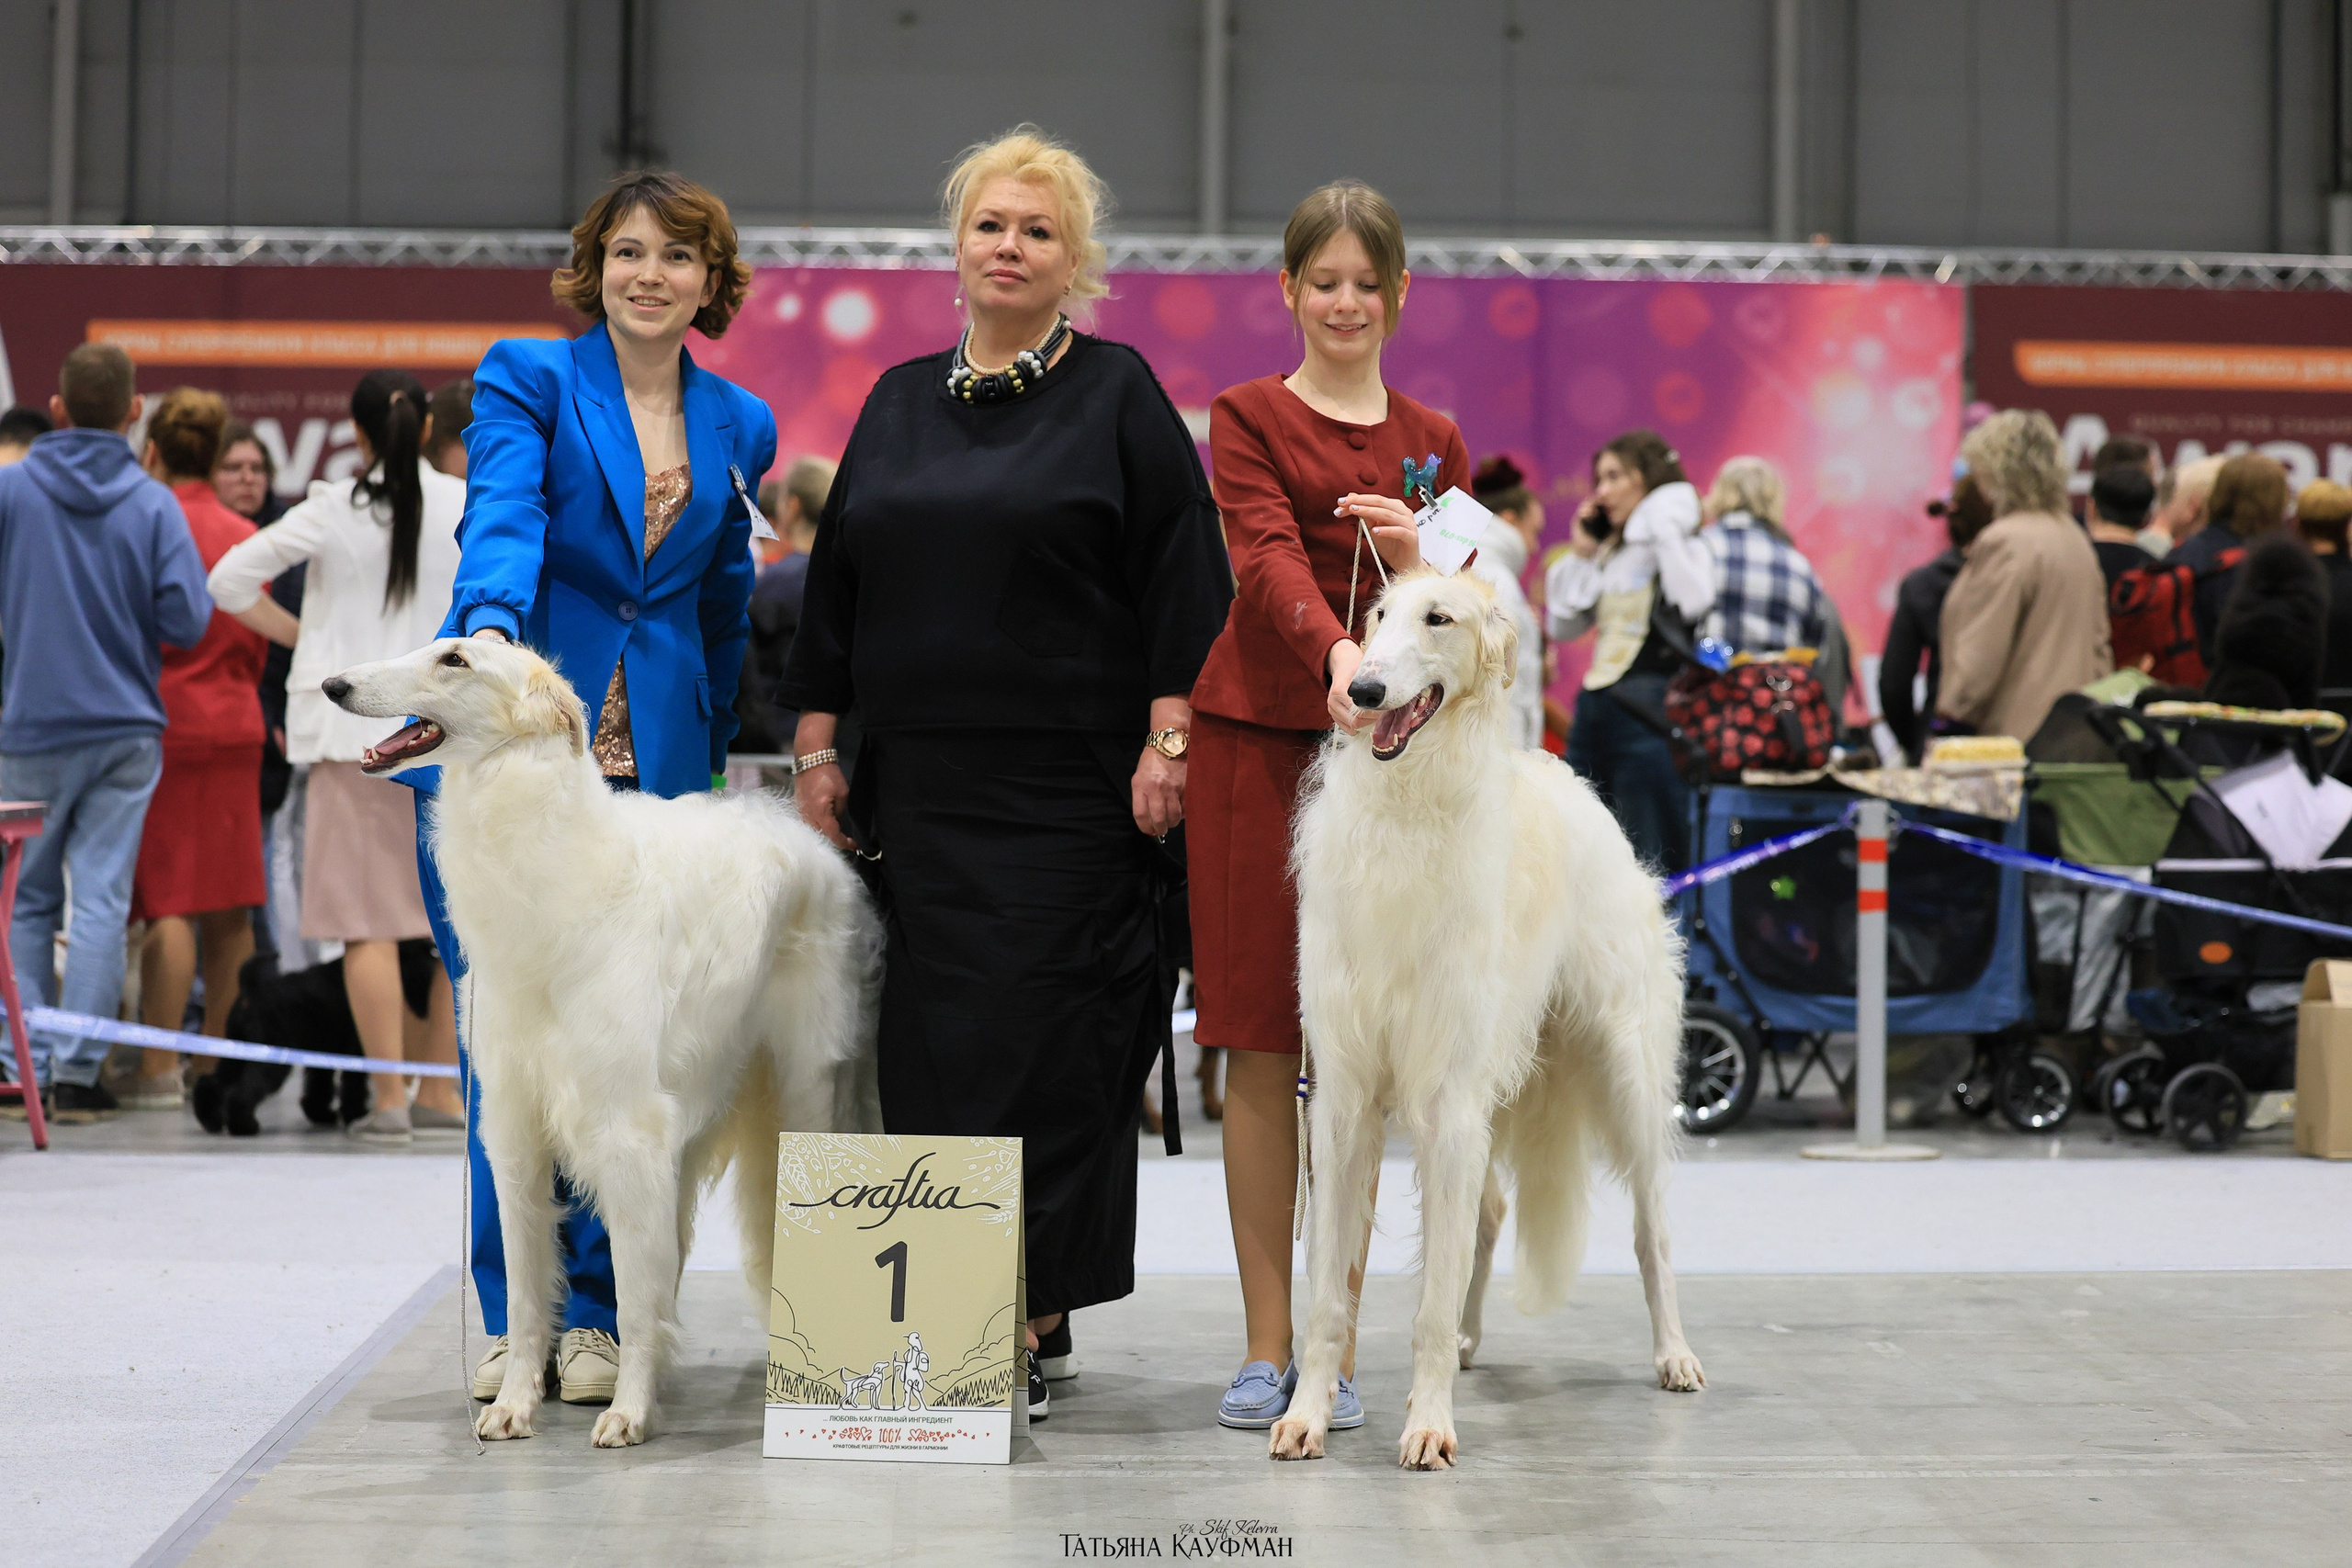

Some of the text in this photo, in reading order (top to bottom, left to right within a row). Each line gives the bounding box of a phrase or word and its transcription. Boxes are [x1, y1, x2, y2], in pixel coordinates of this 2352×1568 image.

[789, 1152, 1001, 1229] craftia
[875, 1241, 908, 1323] 1
[878, 1427, 901, 1443] 100%
